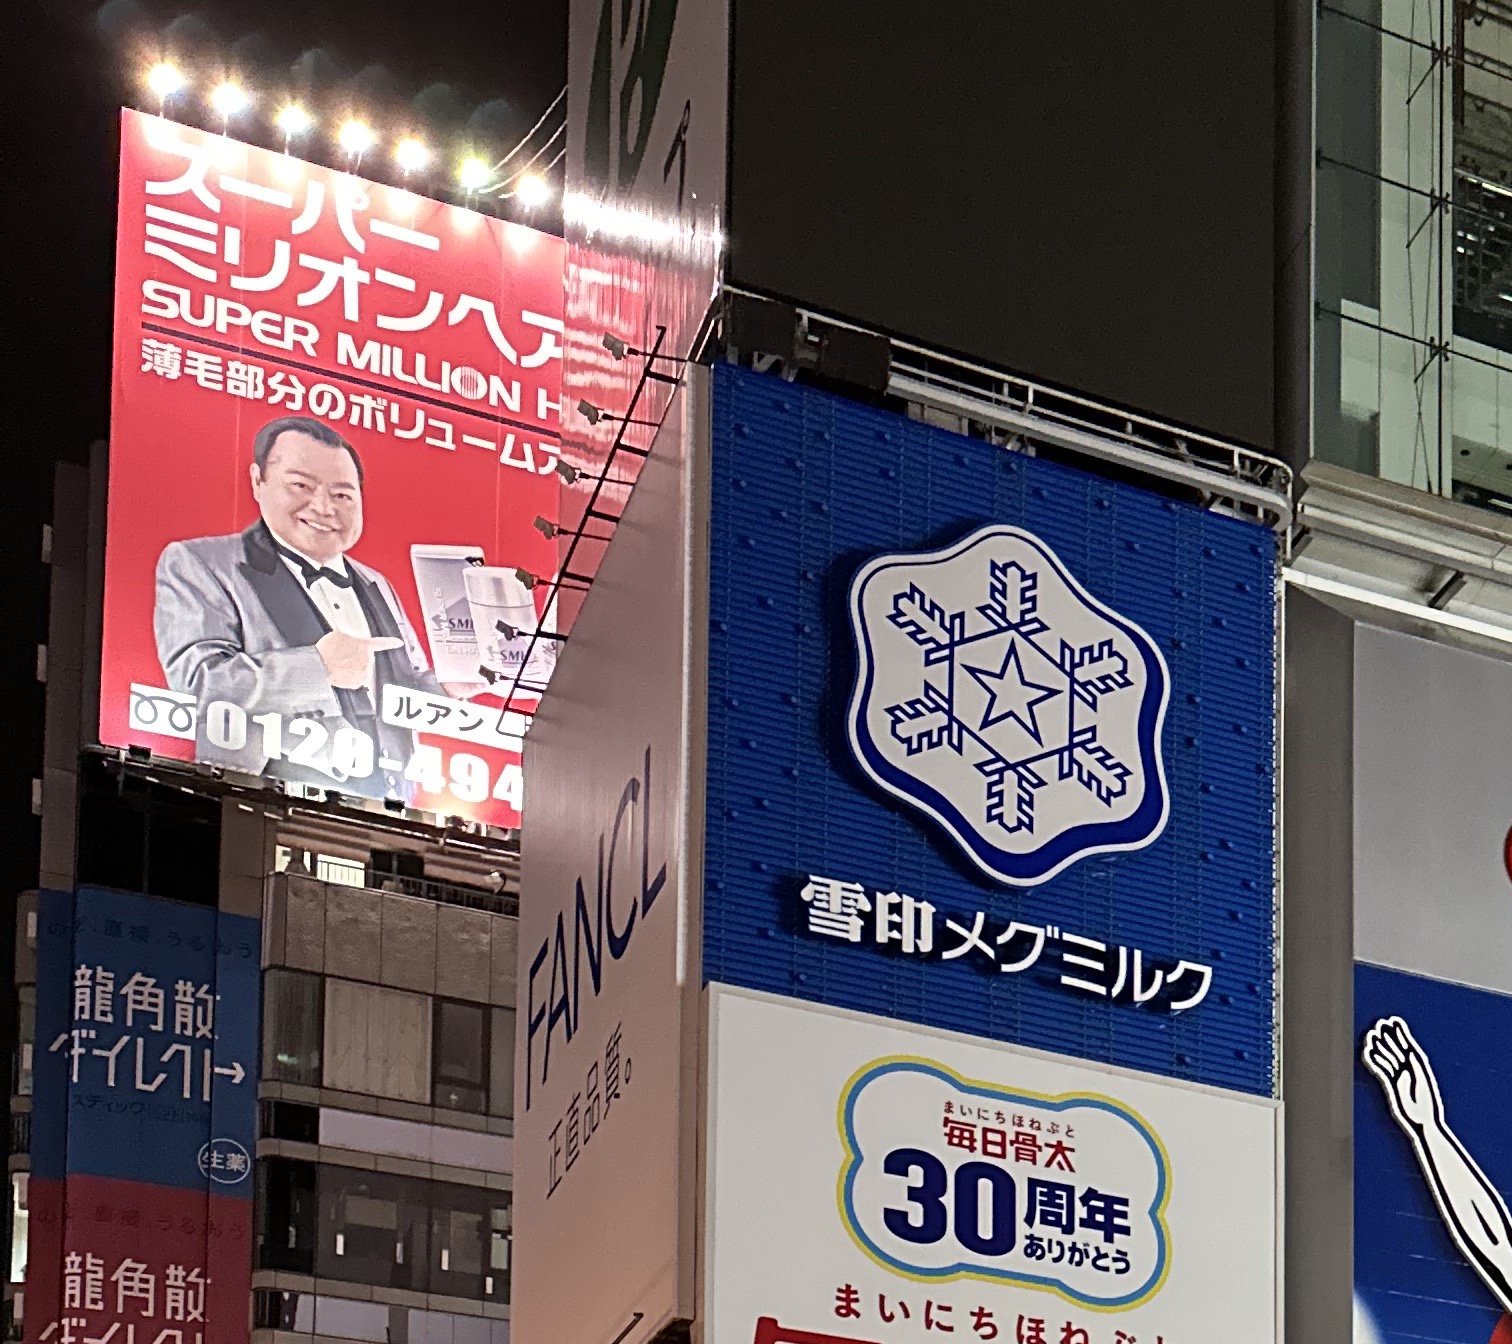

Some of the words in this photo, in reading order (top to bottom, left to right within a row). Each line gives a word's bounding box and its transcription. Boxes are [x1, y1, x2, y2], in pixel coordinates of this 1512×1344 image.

[141, 279, 319, 358] SUPER
[337, 333, 522, 414] MILLION
[525, 744, 668, 1112] FANCL
[800, 873, 1214, 1011] 雪印メグミルク
[74, 964, 220, 1040] 龍角散
[49, 1029, 228, 1102] ダイレクト
[942, 1116, 1076, 1173] 毎日骨太
[943, 1100, 1076, 1139] まいにちほねぶと
[201, 1150, 247, 1175] 生薬
[64, 1251, 211, 1322] 龍角散
[1022, 1231, 1132, 1276] ありがとう
